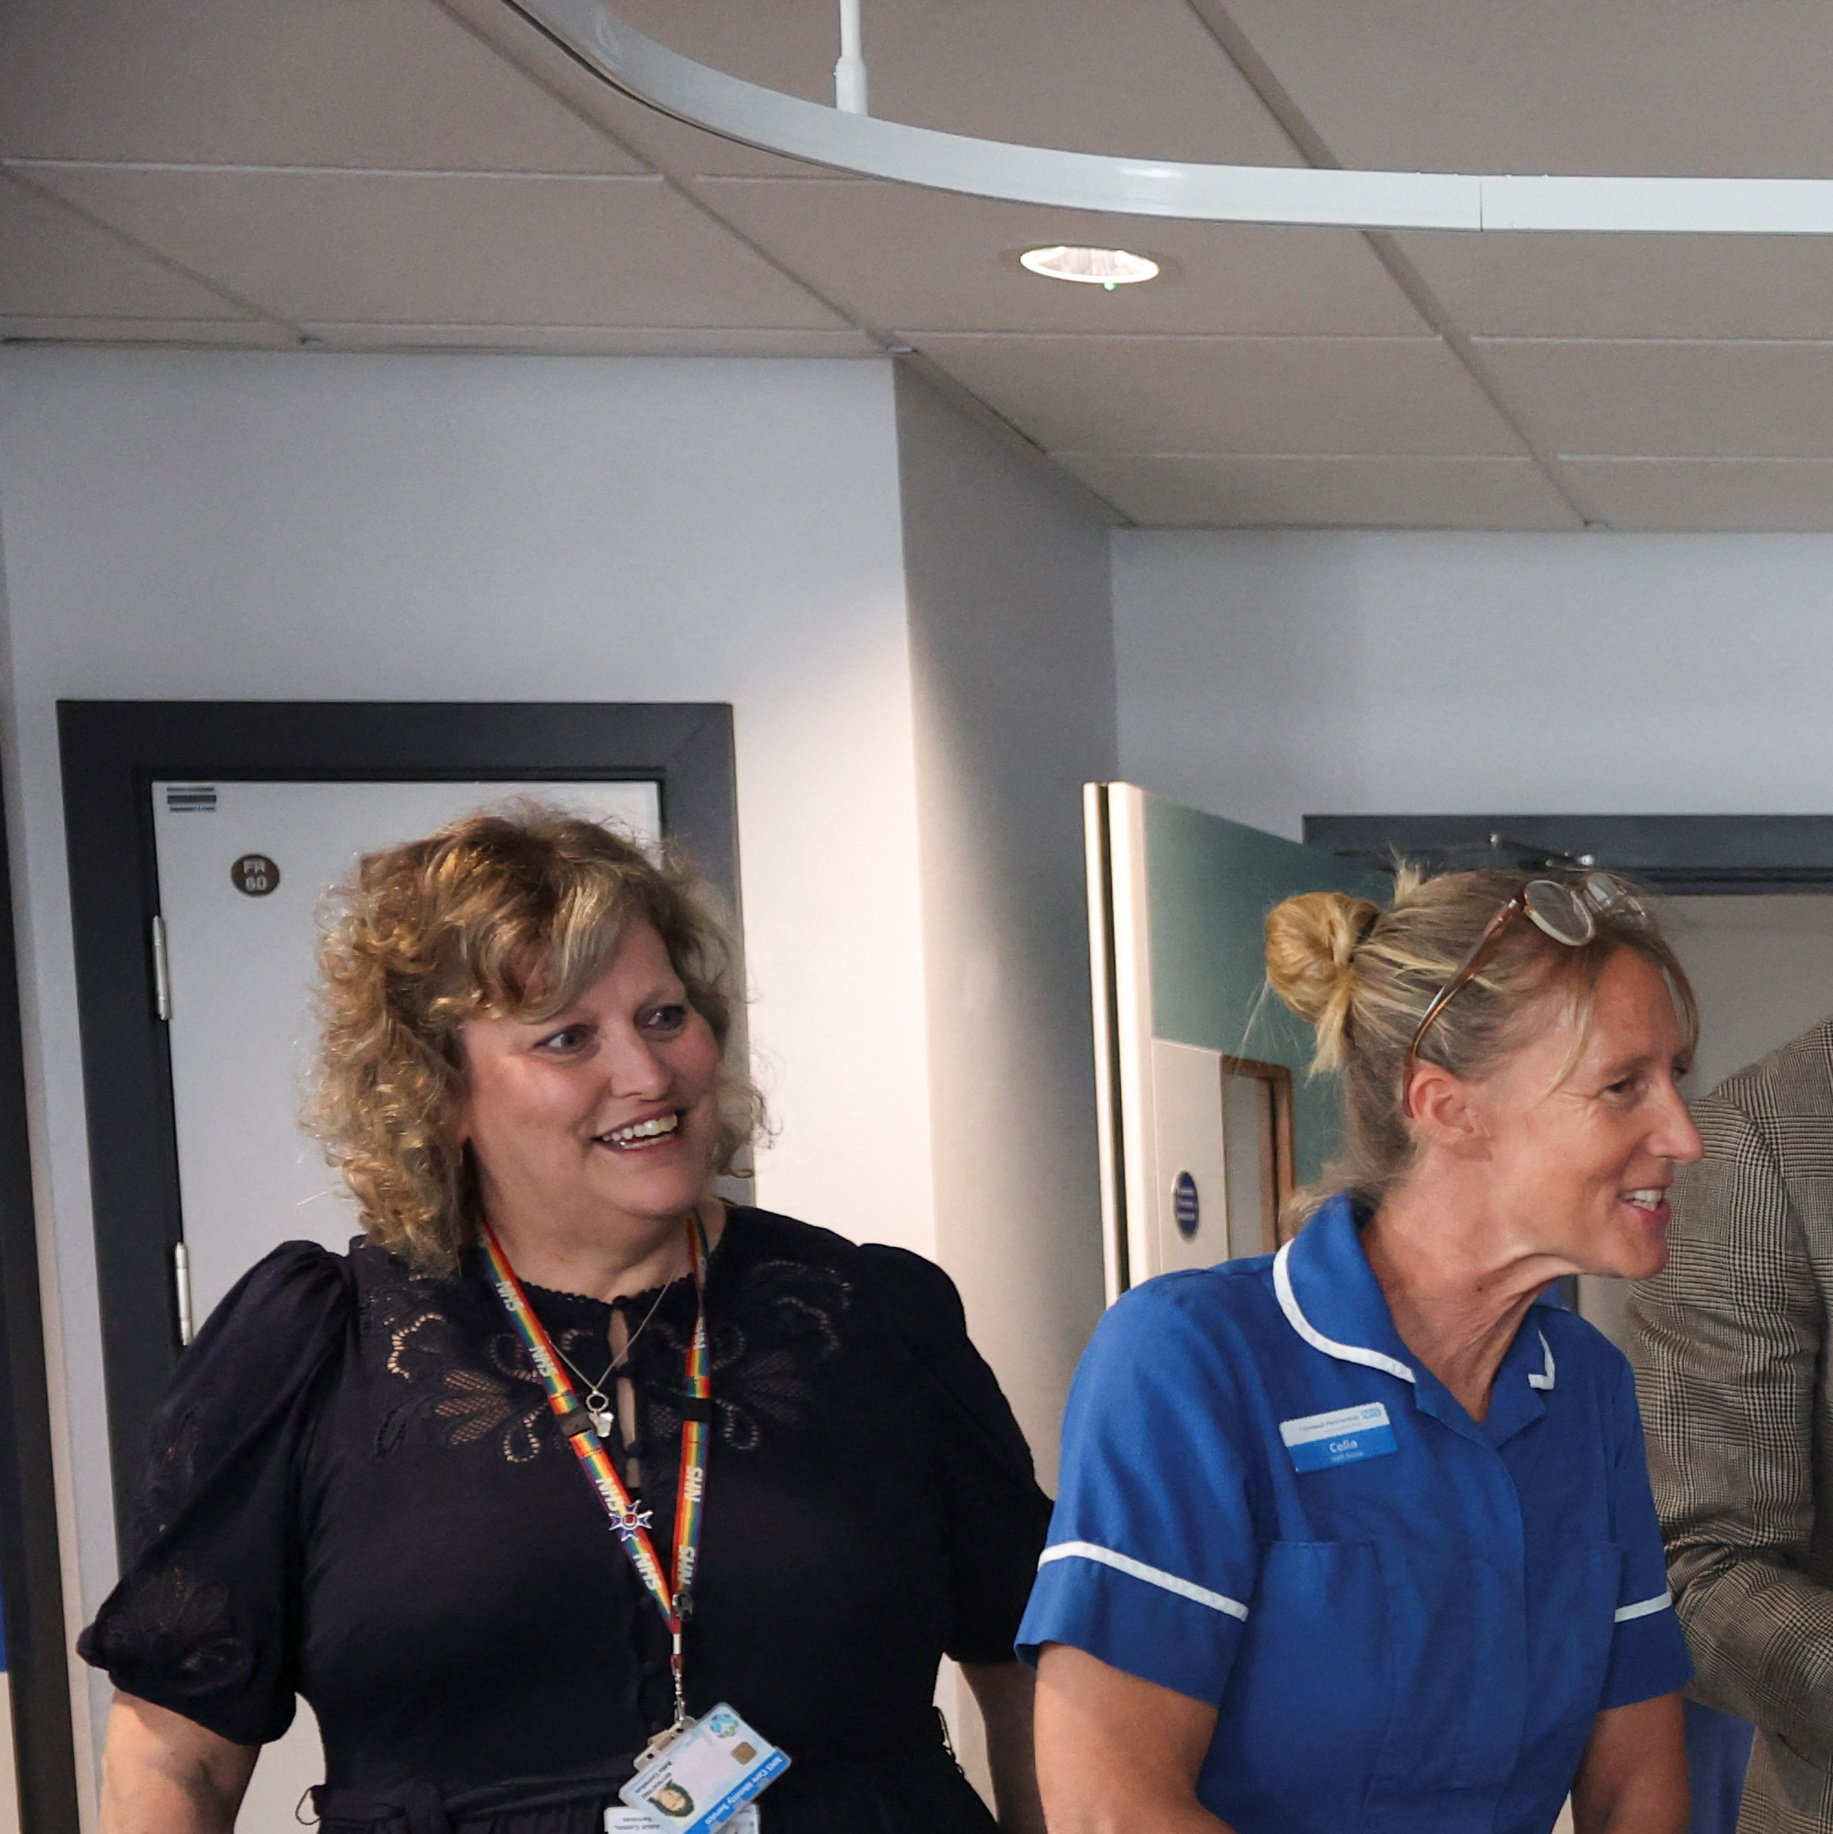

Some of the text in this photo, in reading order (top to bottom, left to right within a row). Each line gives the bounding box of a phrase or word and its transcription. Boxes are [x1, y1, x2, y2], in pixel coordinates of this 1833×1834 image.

[496, 1281, 525, 1312] NHS
[529, 1345, 559, 1378] NHS
[684, 1466, 703, 1503] NHS
[633, 1552, 662, 1590] NHS
[677, 1545, 696, 1585] NHS
